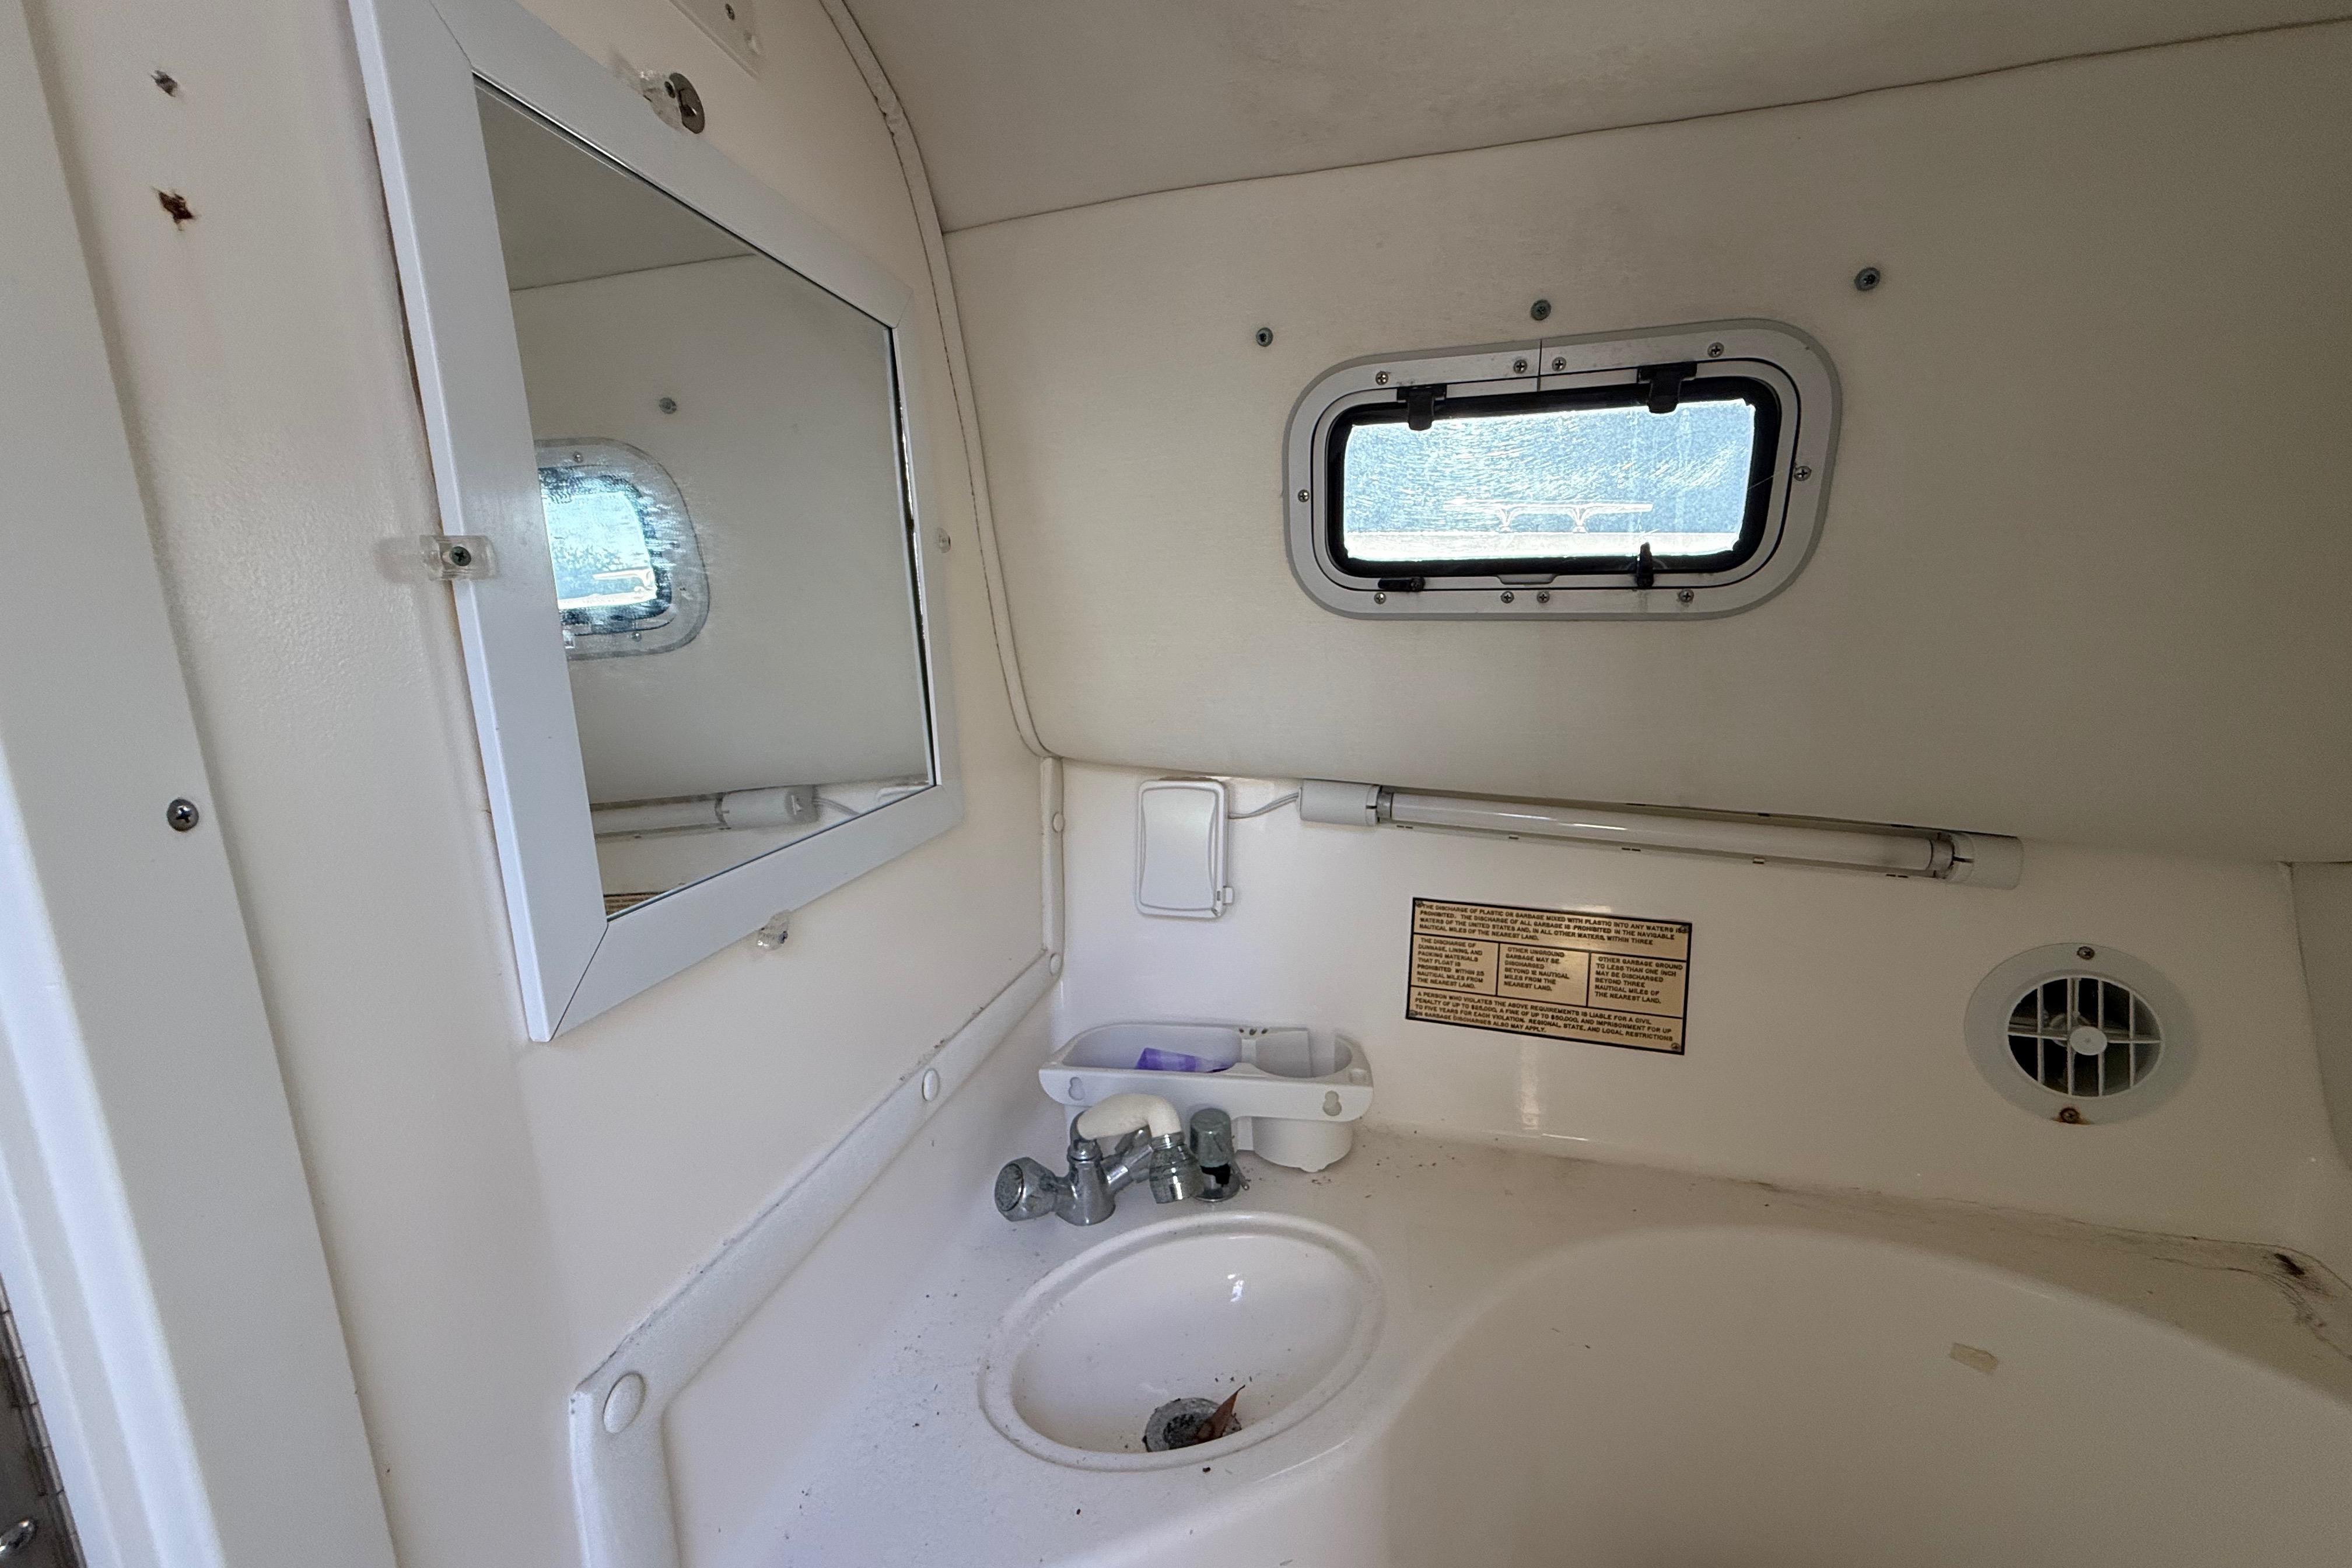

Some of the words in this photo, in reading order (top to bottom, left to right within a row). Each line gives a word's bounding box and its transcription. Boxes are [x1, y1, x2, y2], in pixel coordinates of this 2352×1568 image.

[1573, 925, 1611, 933] PROHIBITED
[1637, 931, 1674, 939] NAVIGABLE
[1417, 964, 1451, 972] PROHIBITED
[1622, 958, 1652, 967] GARBAGE
[1655, 962, 1683, 970] GROUND
[1539, 971, 1569, 979] NAUTICAL
[1595, 984, 1626, 992] NAUTICAL
[1609, 993, 1640, 1001] NEAREST
[1464, 996, 1492, 1005] VIOLATES
[1530, 1005, 1578, 1015] REQUIREMENTS
[1453, 1016, 1492, 1025] DISCHARGES
[1596, 1020, 1645, 1030] IMPRISONMENT
[1625, 1030, 1672, 1041] RESTRICTIONS
